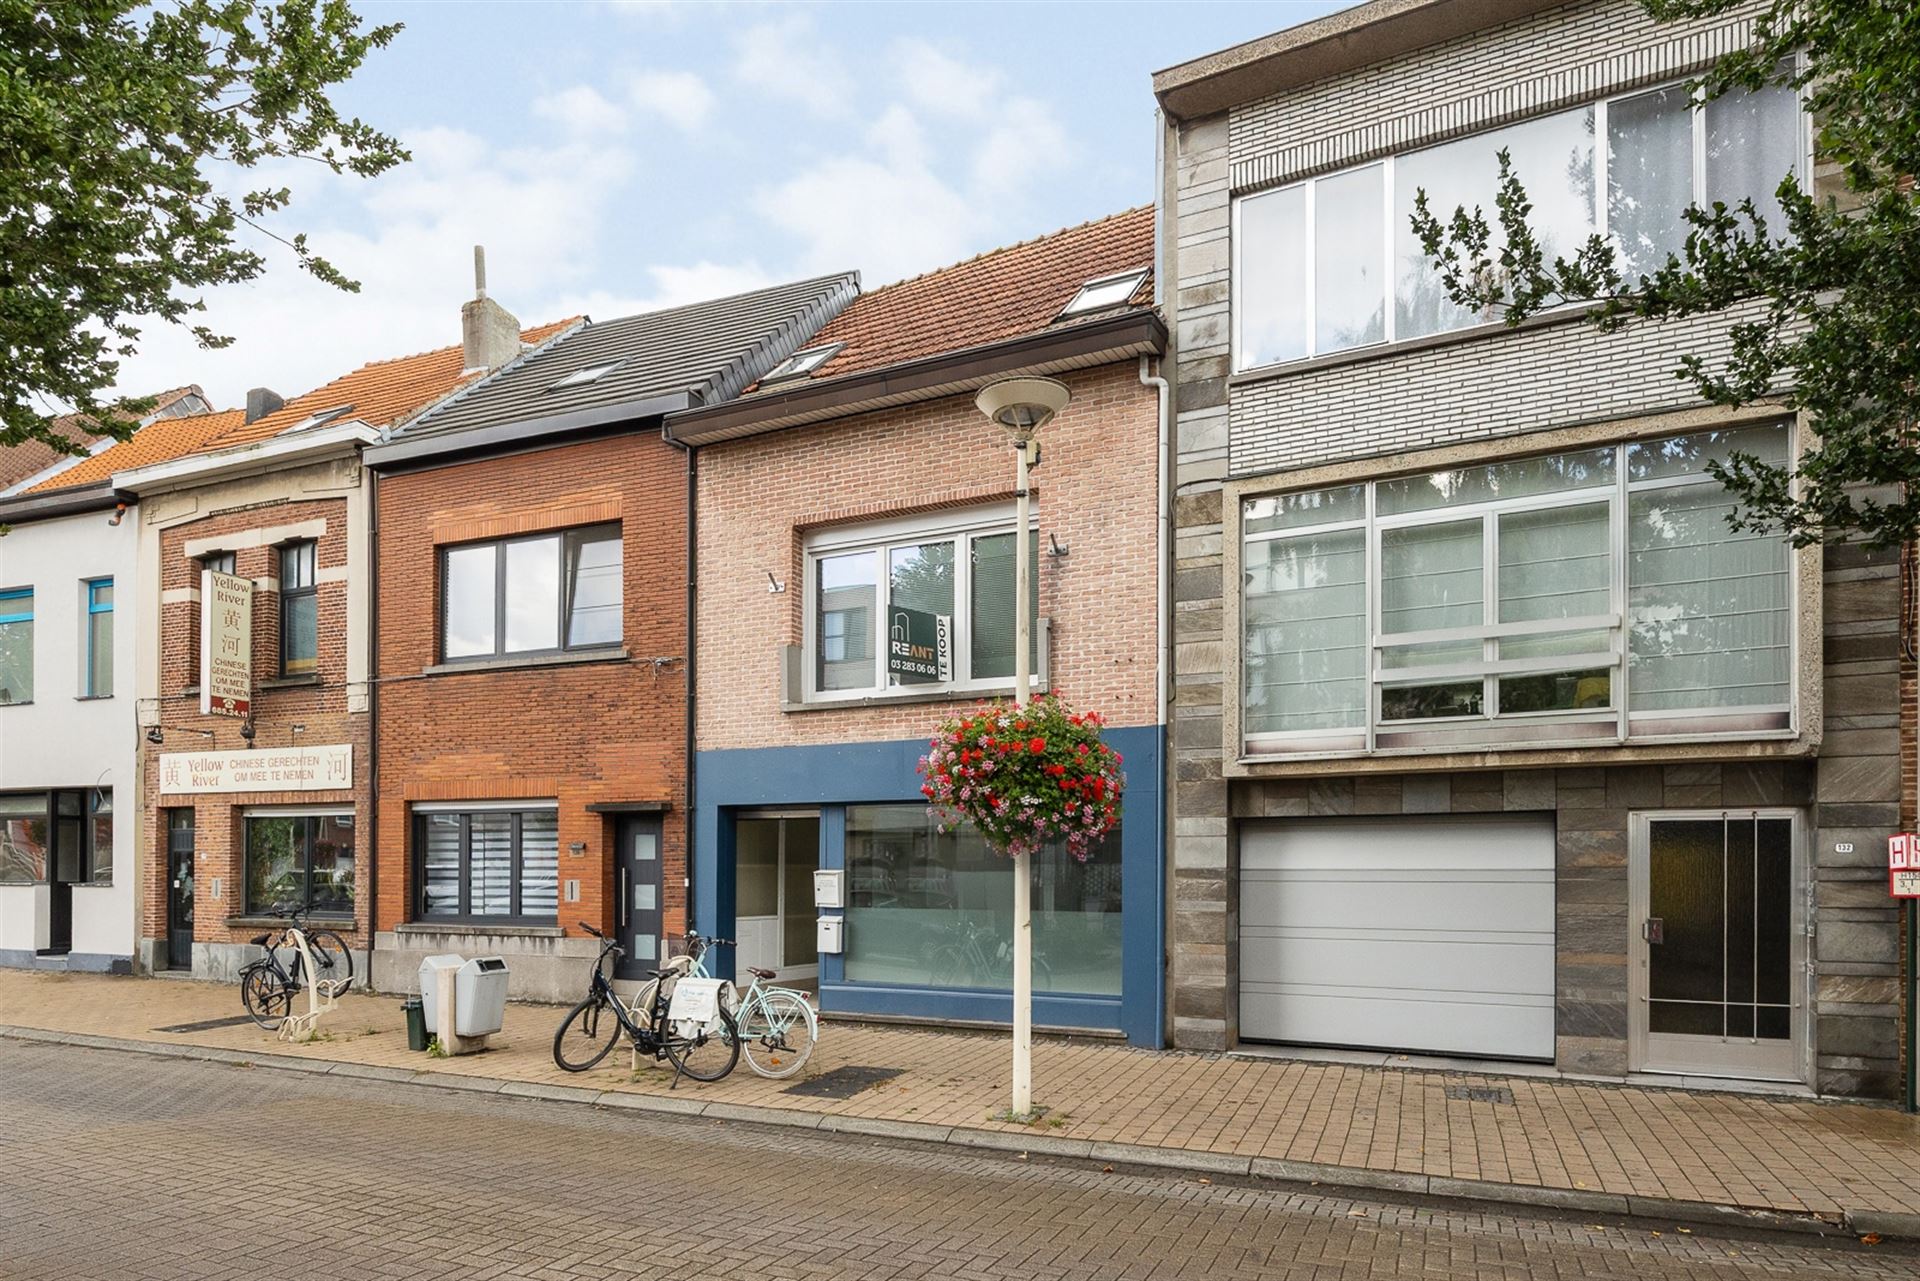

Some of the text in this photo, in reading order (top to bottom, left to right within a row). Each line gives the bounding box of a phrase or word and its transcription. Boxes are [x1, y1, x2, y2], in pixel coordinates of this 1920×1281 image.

[213, 575, 249, 593] Yellow
[217, 591, 245, 606] River
[892, 641, 934, 660] REANT
[938, 618, 948, 677] TE KOOP
[215, 657, 247, 671] CHINESE
[891, 659, 901, 669] 03
[902, 661, 916, 672] 283
[916, 663, 926, 673] 06
[211, 666, 250, 680] GERECHTEN
[215, 676, 246, 689] OM MEE
[212, 685, 249, 698] TE NEMEN
[187, 758, 225, 773] Yellow
[229, 756, 320, 770] CHINESE GERECHTEN
[192, 772, 220, 787] River
[234, 769, 315, 783] OM MEE TE NEMEN
[1892, 840, 1904, 864] H
